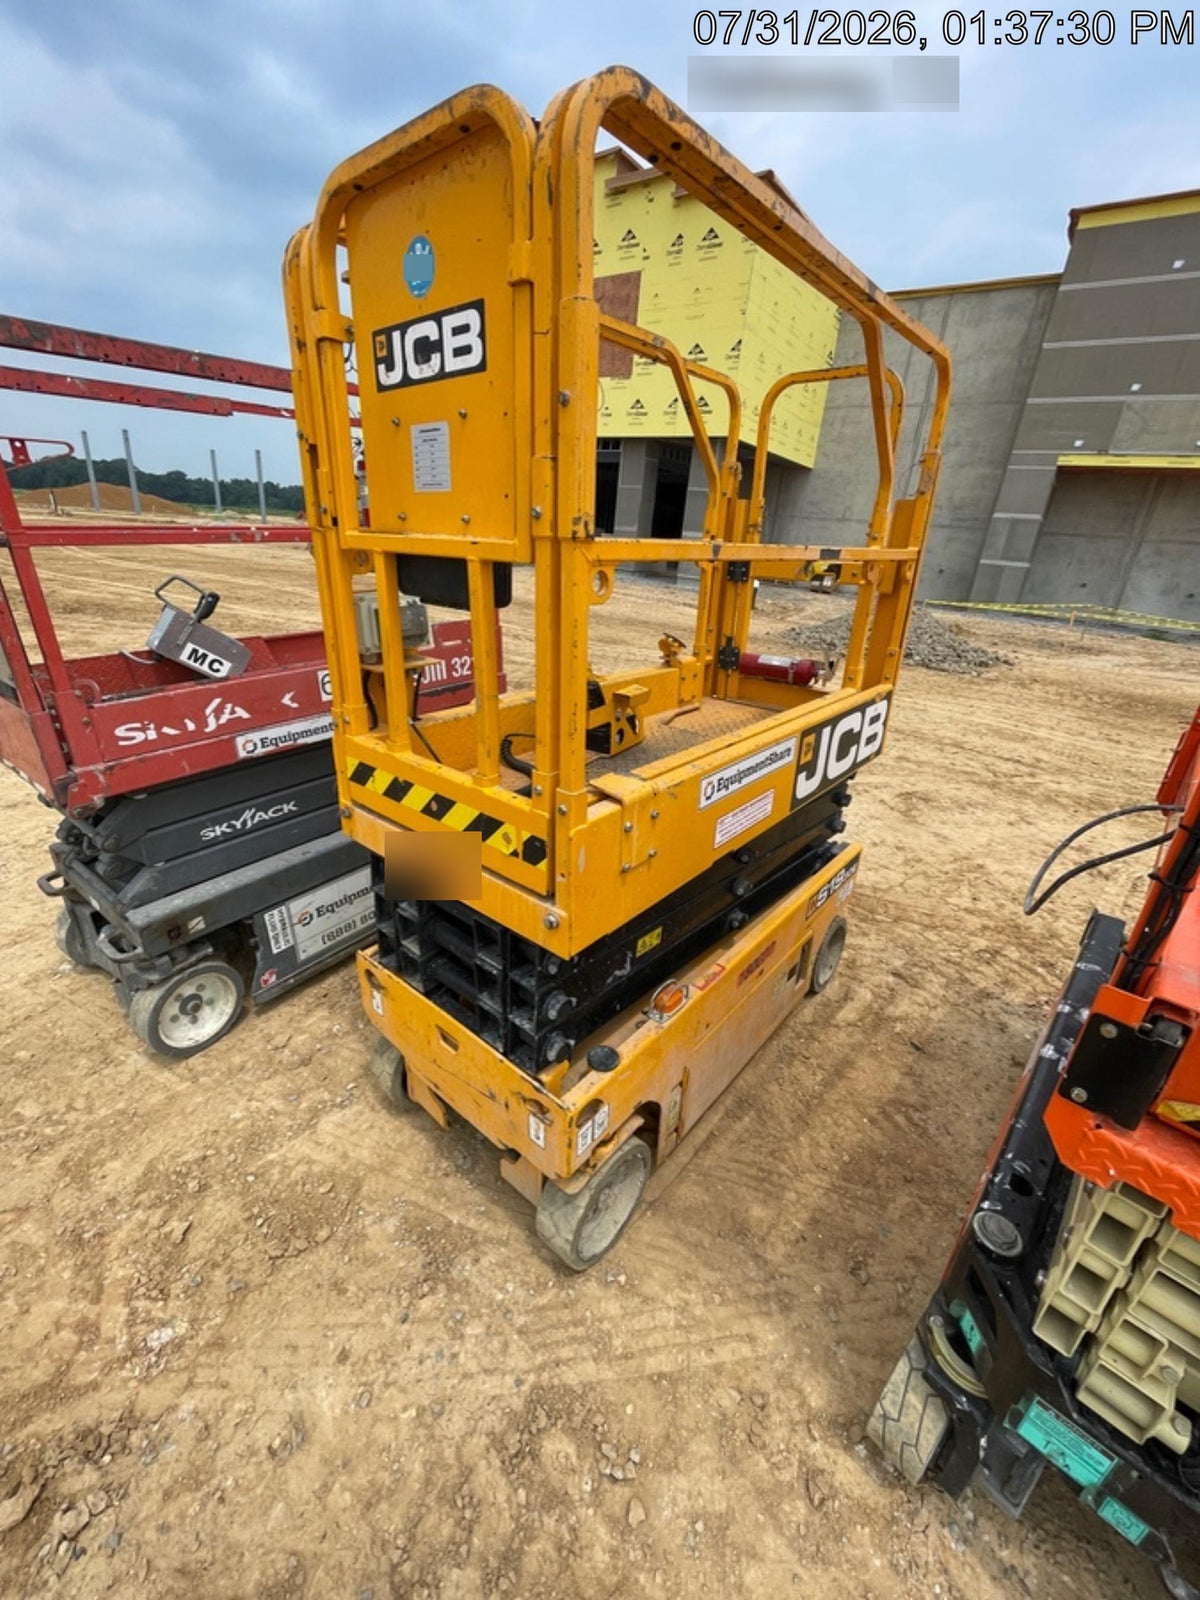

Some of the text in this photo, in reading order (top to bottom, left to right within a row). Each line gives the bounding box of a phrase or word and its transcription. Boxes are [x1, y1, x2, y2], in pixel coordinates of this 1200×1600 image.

[377, 308, 484, 387] JCB
[187, 648, 224, 674] MC
[716, 746, 792, 793] EquipmentShare
[796, 699, 888, 799] JCB
[201, 800, 298, 841] SKYJACK
